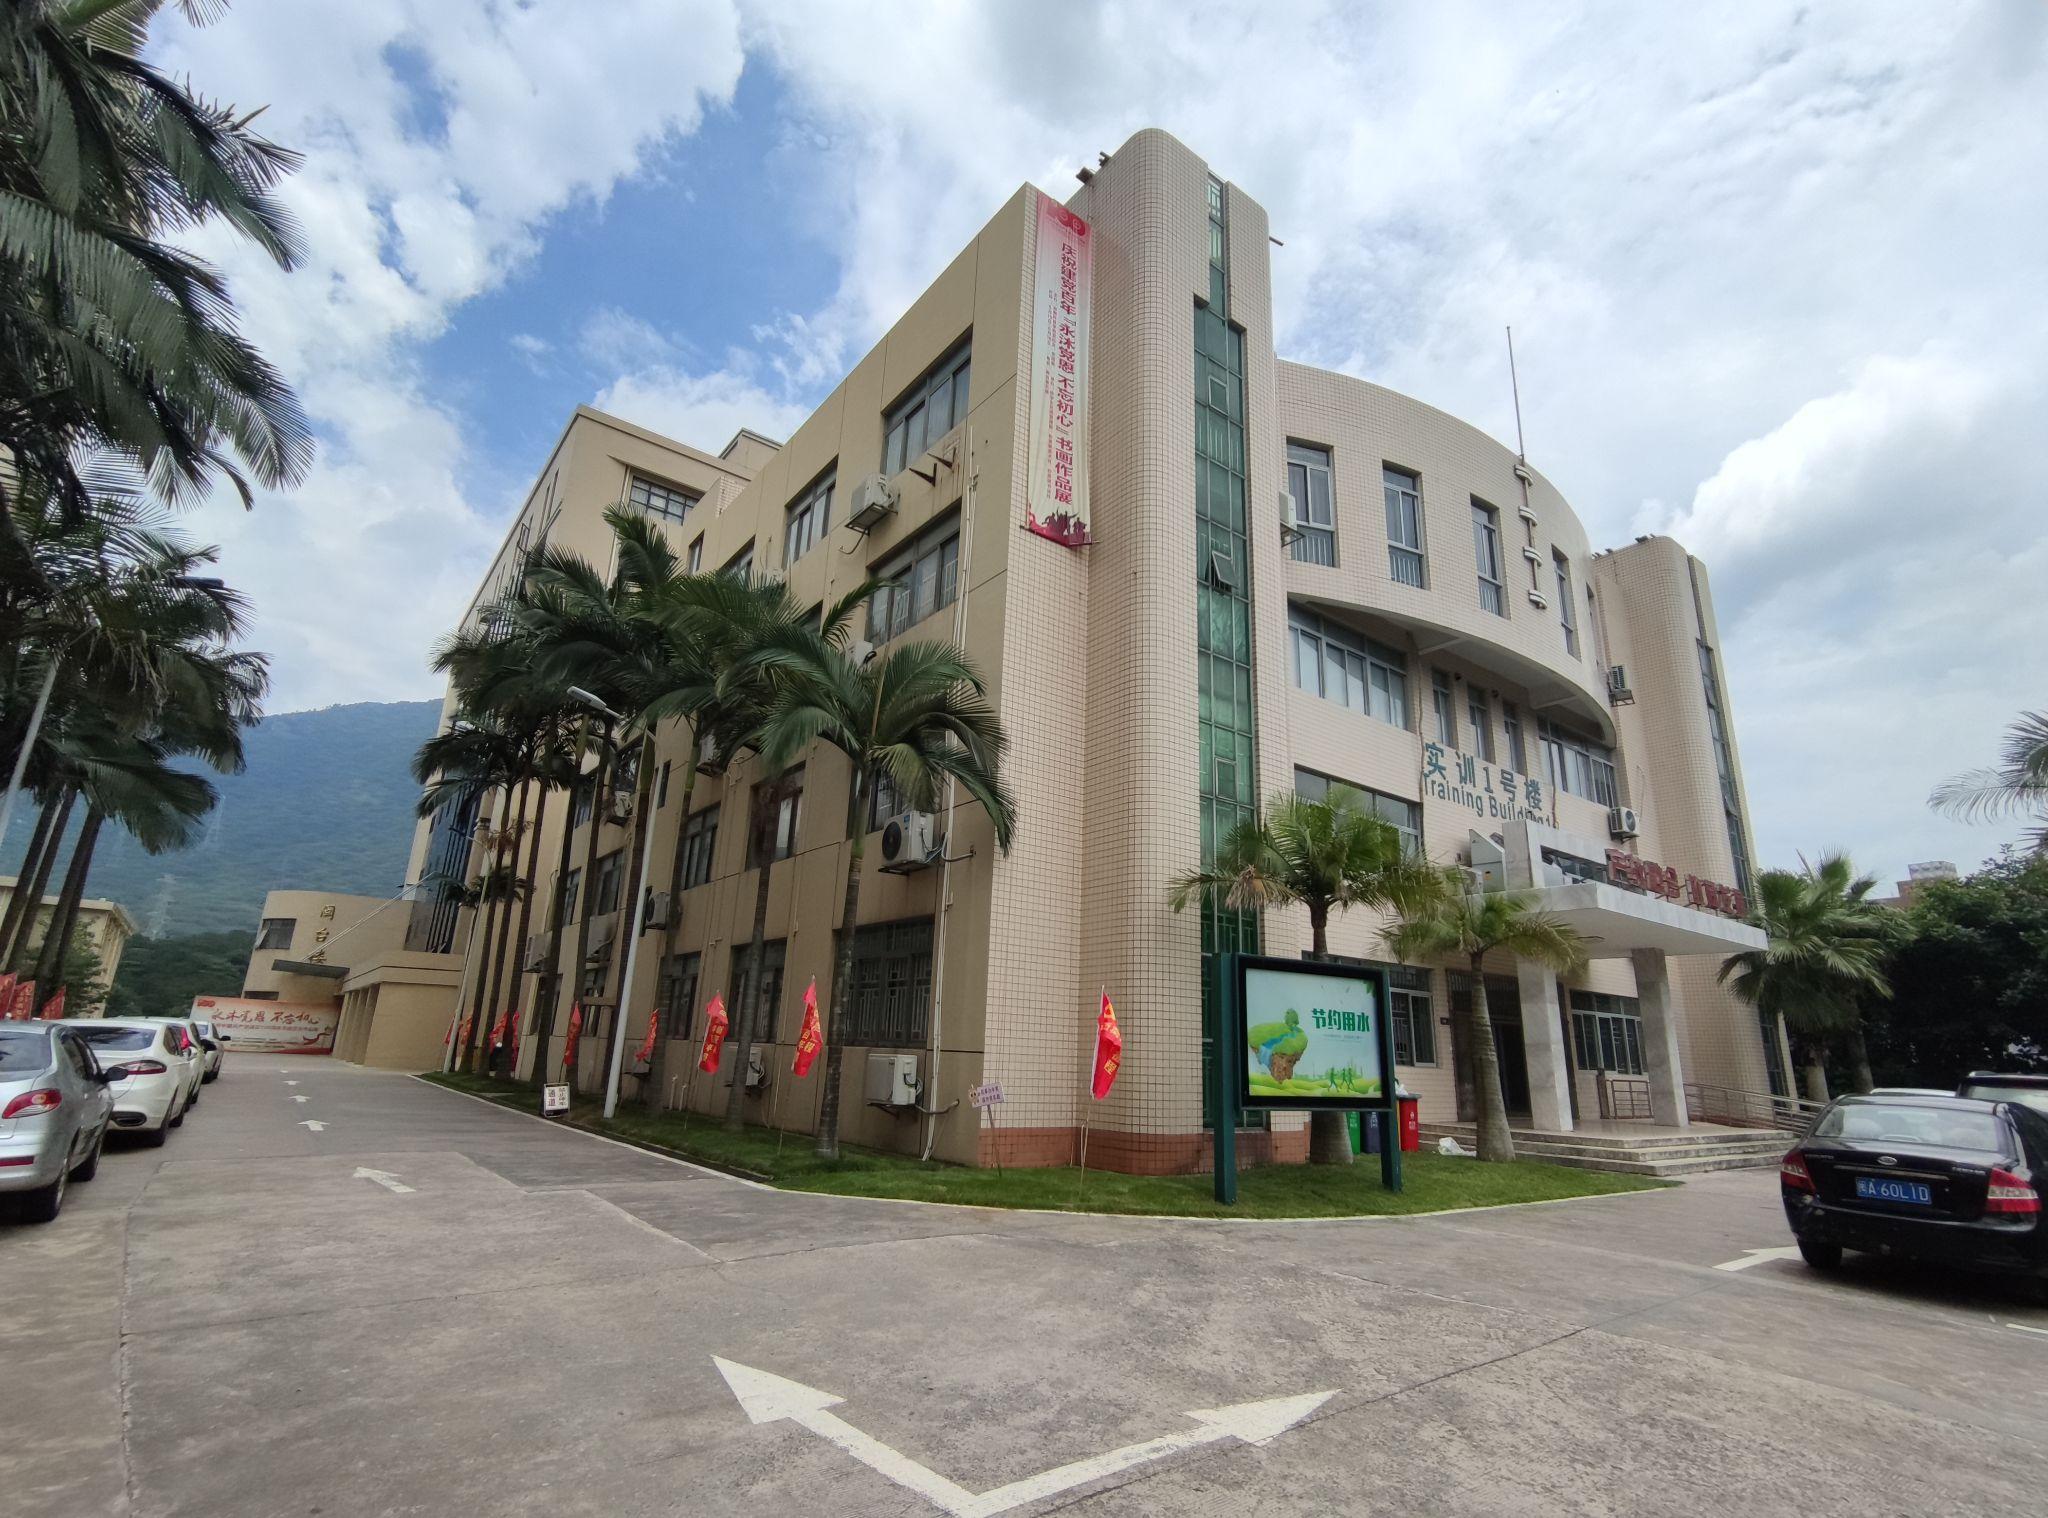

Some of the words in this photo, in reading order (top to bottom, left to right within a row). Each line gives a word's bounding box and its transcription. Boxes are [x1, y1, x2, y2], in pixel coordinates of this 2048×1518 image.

[1424, 742, 1542, 811] 实训1号楼
[1424, 773, 1483, 818] Training
[1311, 1008, 1370, 1032] 节约用水
